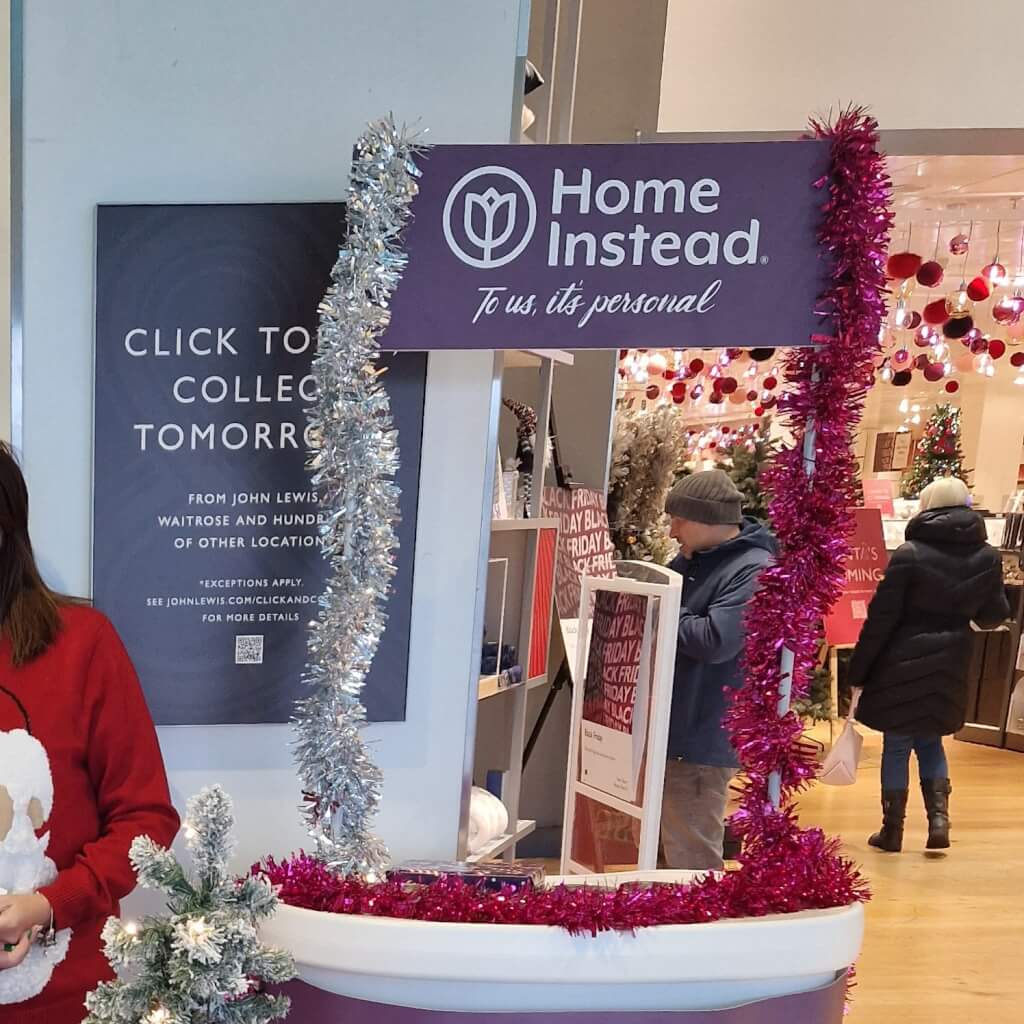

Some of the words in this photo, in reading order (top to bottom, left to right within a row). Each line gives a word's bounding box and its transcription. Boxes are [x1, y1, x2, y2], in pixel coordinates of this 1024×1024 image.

[551, 168, 720, 215] Home
[472, 285, 508, 324] To
[504, 293, 538, 318] us,
[546, 280, 584, 315] it's
[577, 279, 723, 328] personal
[125, 328, 238, 356] CLICK
[173, 374, 319, 403] COLLEC
[188, 493, 226, 505] FROM
[232, 492, 270, 506] JOHN
[158, 515, 229, 527] WAITROSE
[235, 515, 267, 526] AND
[174, 537, 192, 549] OF
[198, 537, 245, 549] OTHER
[251, 535, 326, 548] LOCATION
[846, 567, 884, 582] MING
[146, 598, 163, 606] SEE
[167, 596, 319, 608] JOHNLEWIS.COM/CLICKANDC
[202, 614, 222, 623] FOR
[227, 614, 254, 622] MORE
[259, 613, 300, 622] DETAILS
